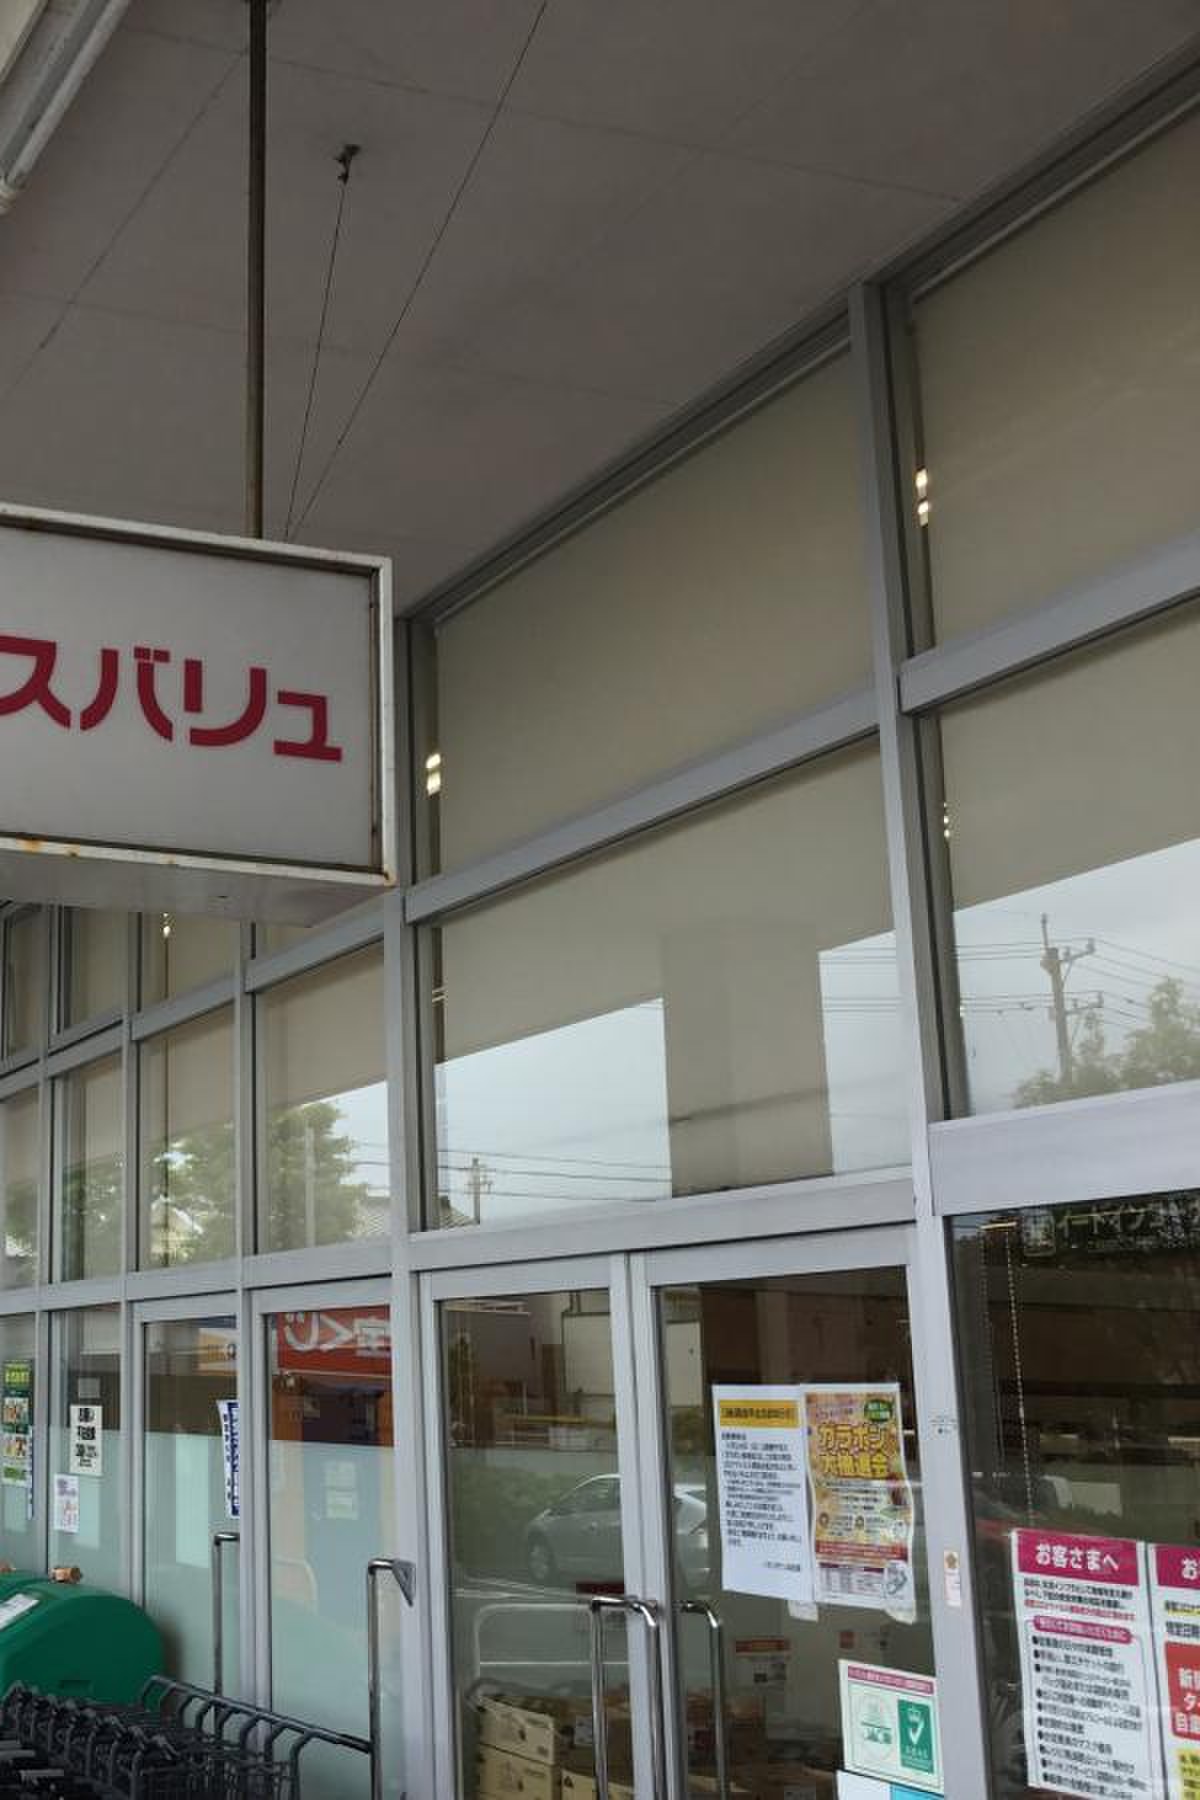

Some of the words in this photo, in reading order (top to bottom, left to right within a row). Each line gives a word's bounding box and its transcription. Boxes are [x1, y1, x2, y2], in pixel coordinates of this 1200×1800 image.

[1036, 1544, 1119, 1571] お客さまへ
[1181, 1556, 1200, 1580] お
